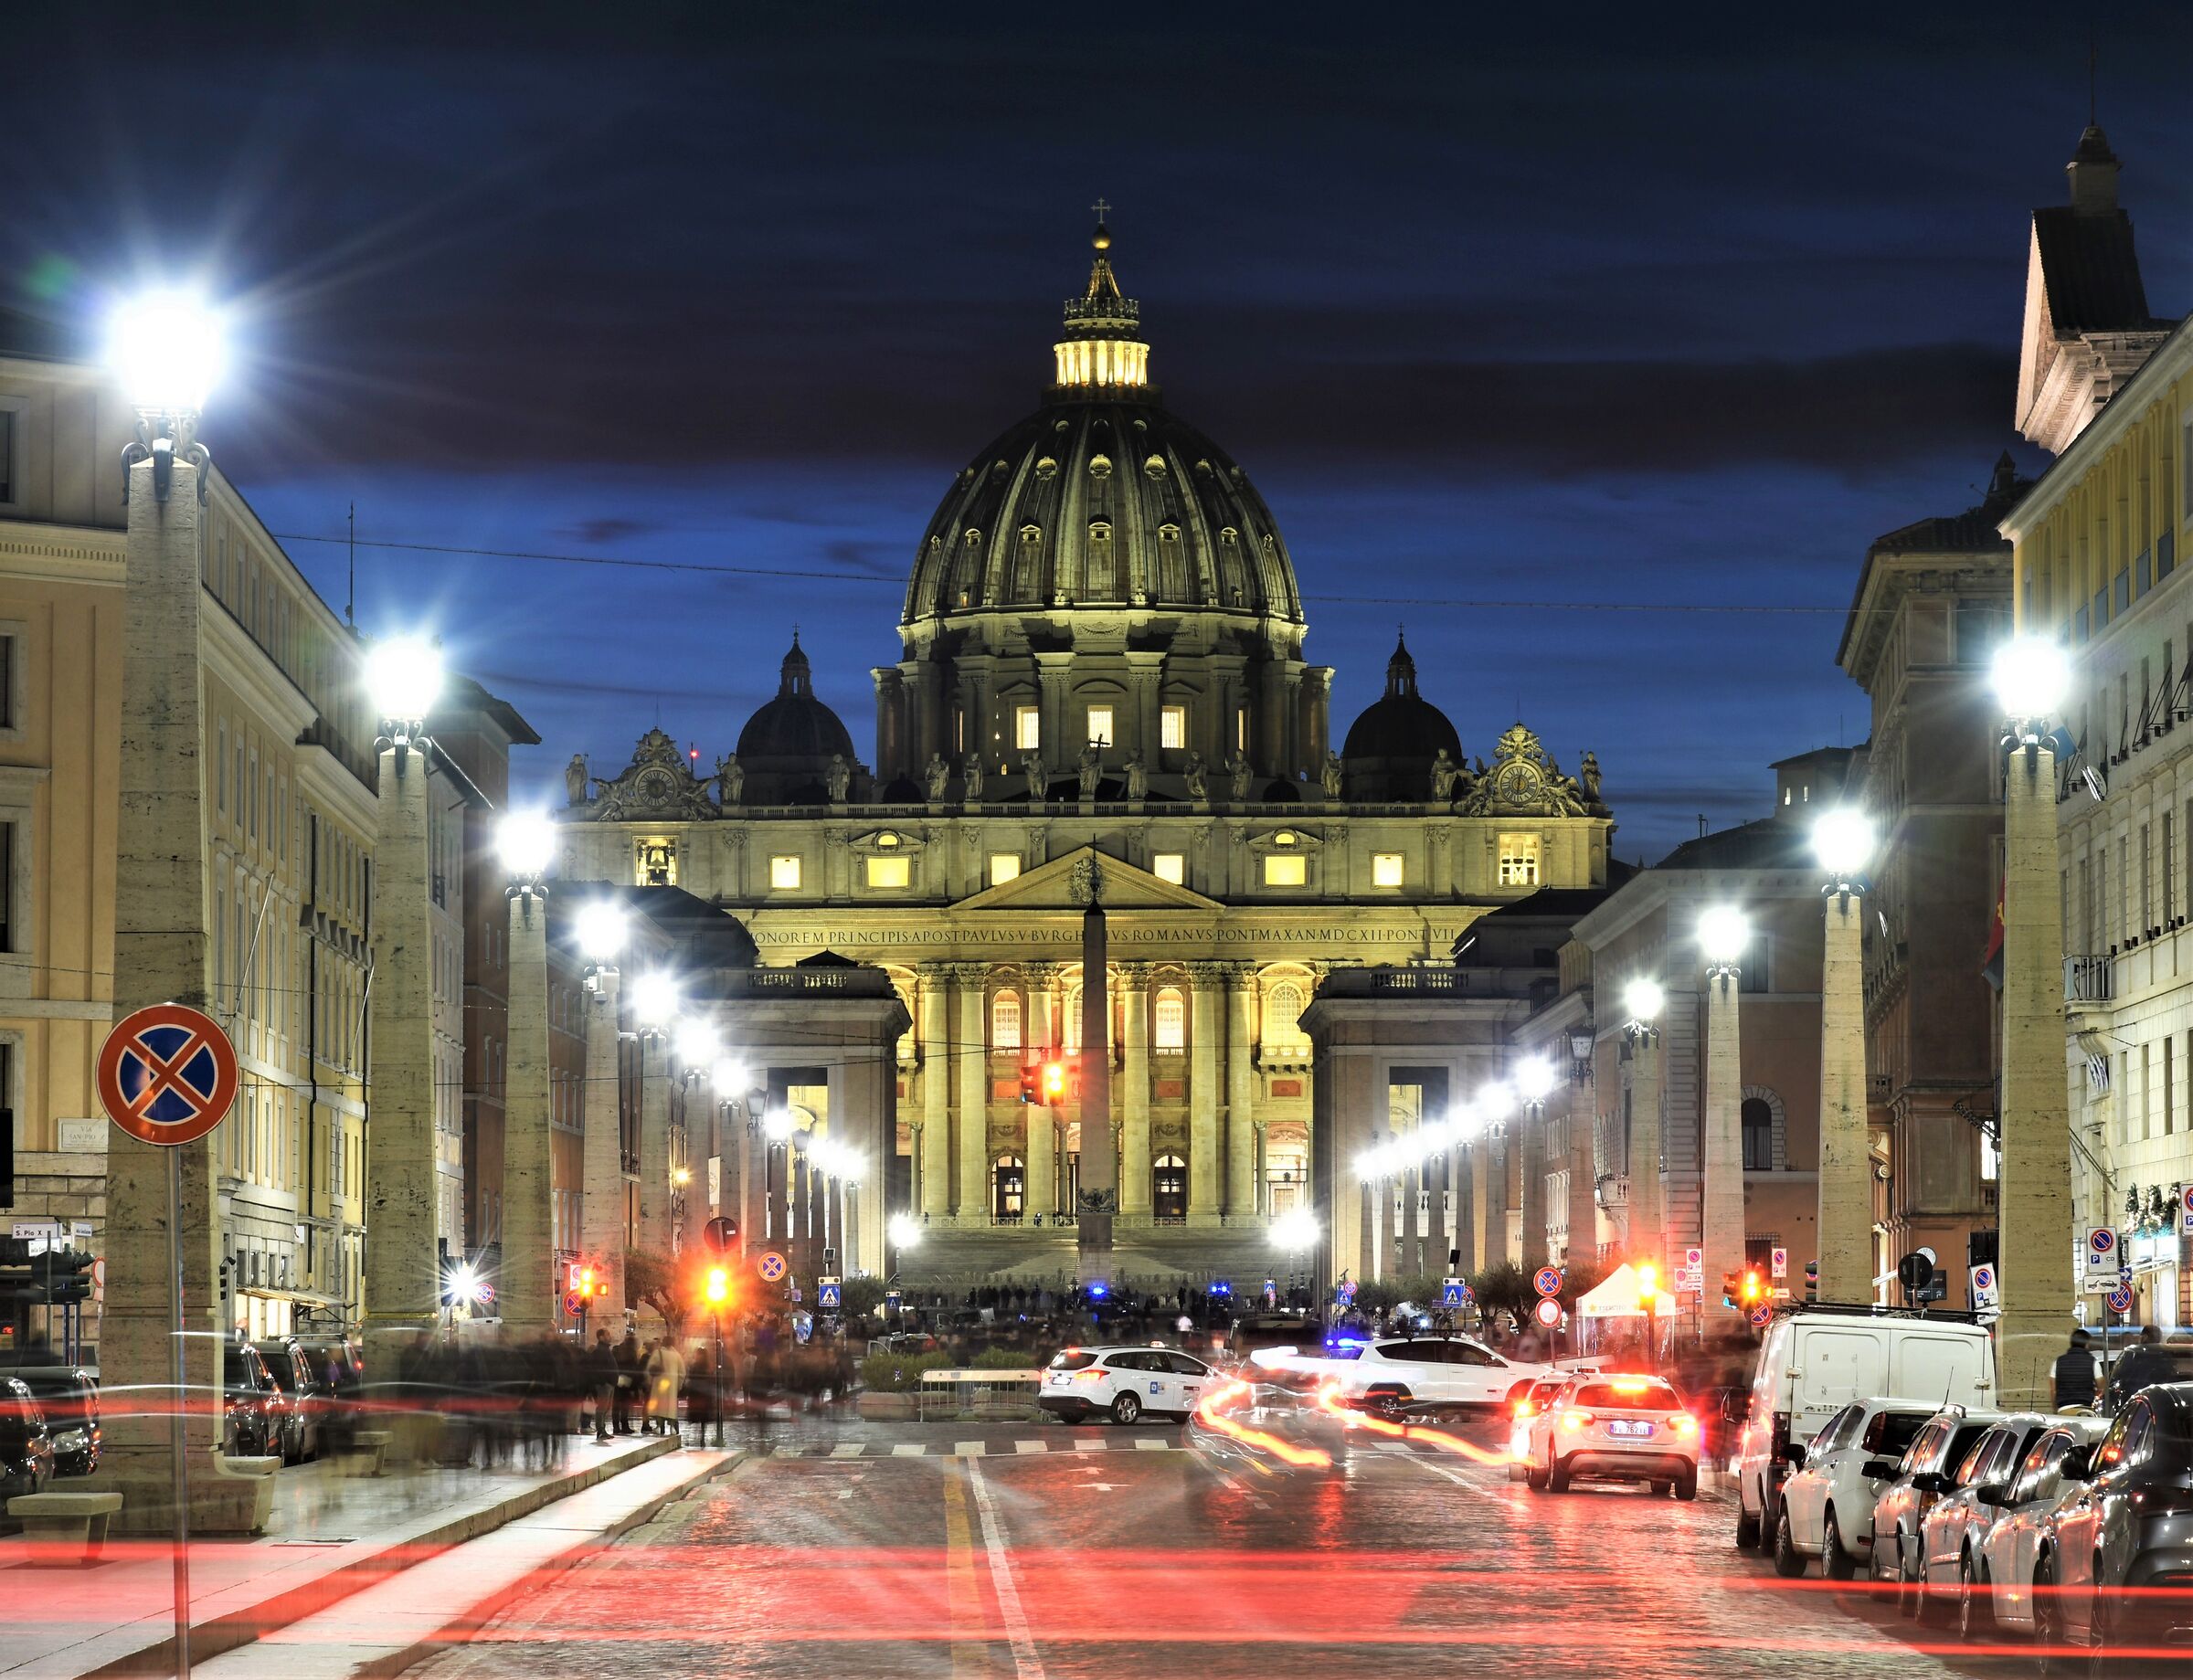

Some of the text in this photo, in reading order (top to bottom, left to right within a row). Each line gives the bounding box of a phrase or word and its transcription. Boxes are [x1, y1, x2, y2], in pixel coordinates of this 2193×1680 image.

[830, 931, 908, 943] PRINCIPIS
[912, 930, 959, 943] APOST
[963, 929, 1014, 942] PAVLVS
[1032, 929, 1128, 942] BVRGHIVS
[1133, 928, 1213, 941] ROMANVS
[1217, 928, 1257, 941] PONT
[1260, 928, 1292, 941] MAX
[1295, 928, 1316, 941] AN
[1319, 928, 1382, 941] MDCXII
[1387, 928, 1427, 941] PONT
[1433, 928, 1454, 940] VII
